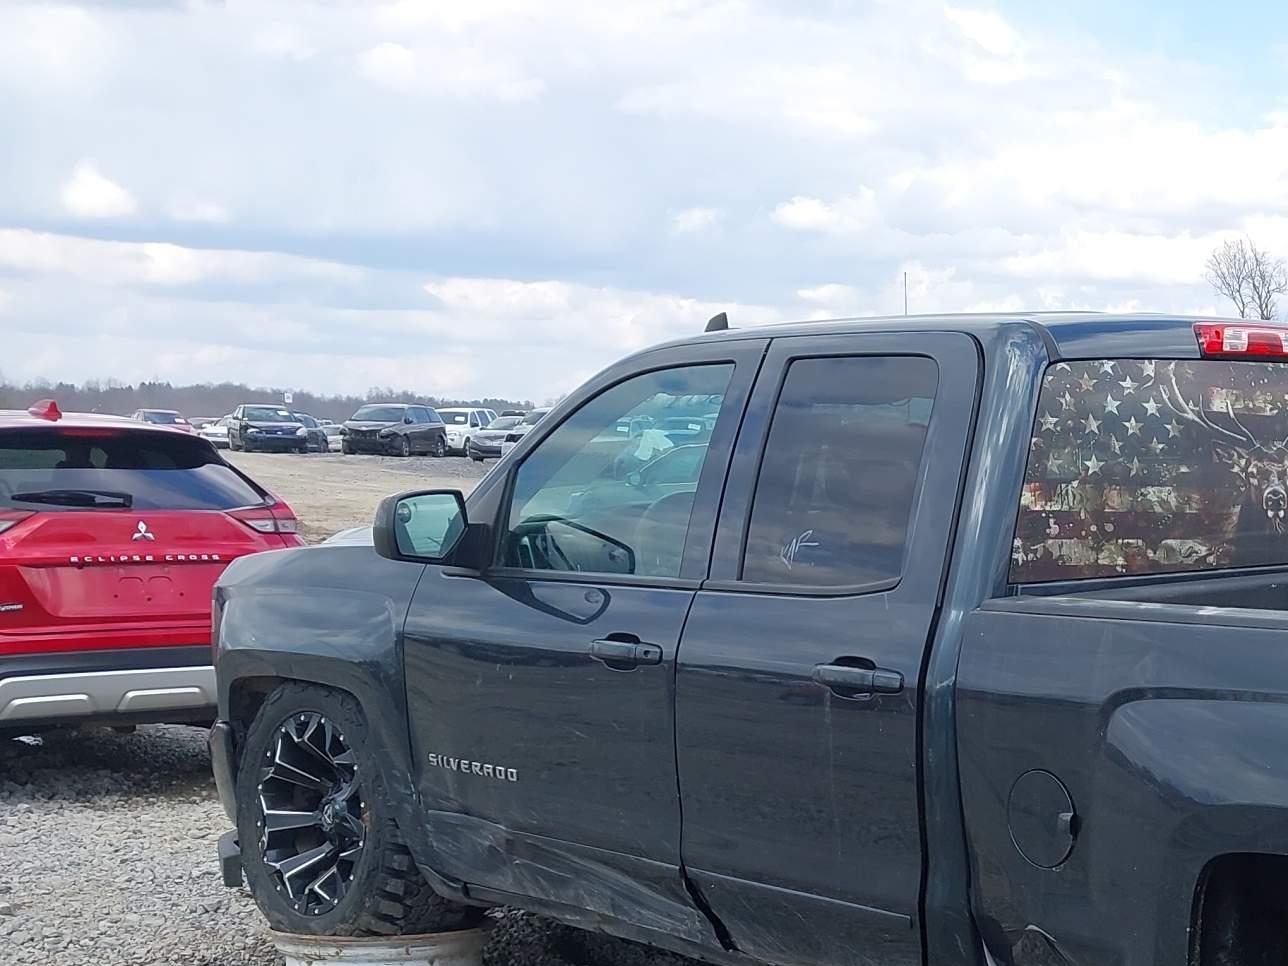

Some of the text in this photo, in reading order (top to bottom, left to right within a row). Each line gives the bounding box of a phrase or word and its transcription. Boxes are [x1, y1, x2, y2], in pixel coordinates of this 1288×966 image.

[70, 553, 221, 563] ECLIPSE CROSS
[428, 752, 519, 783] SILVERADO
